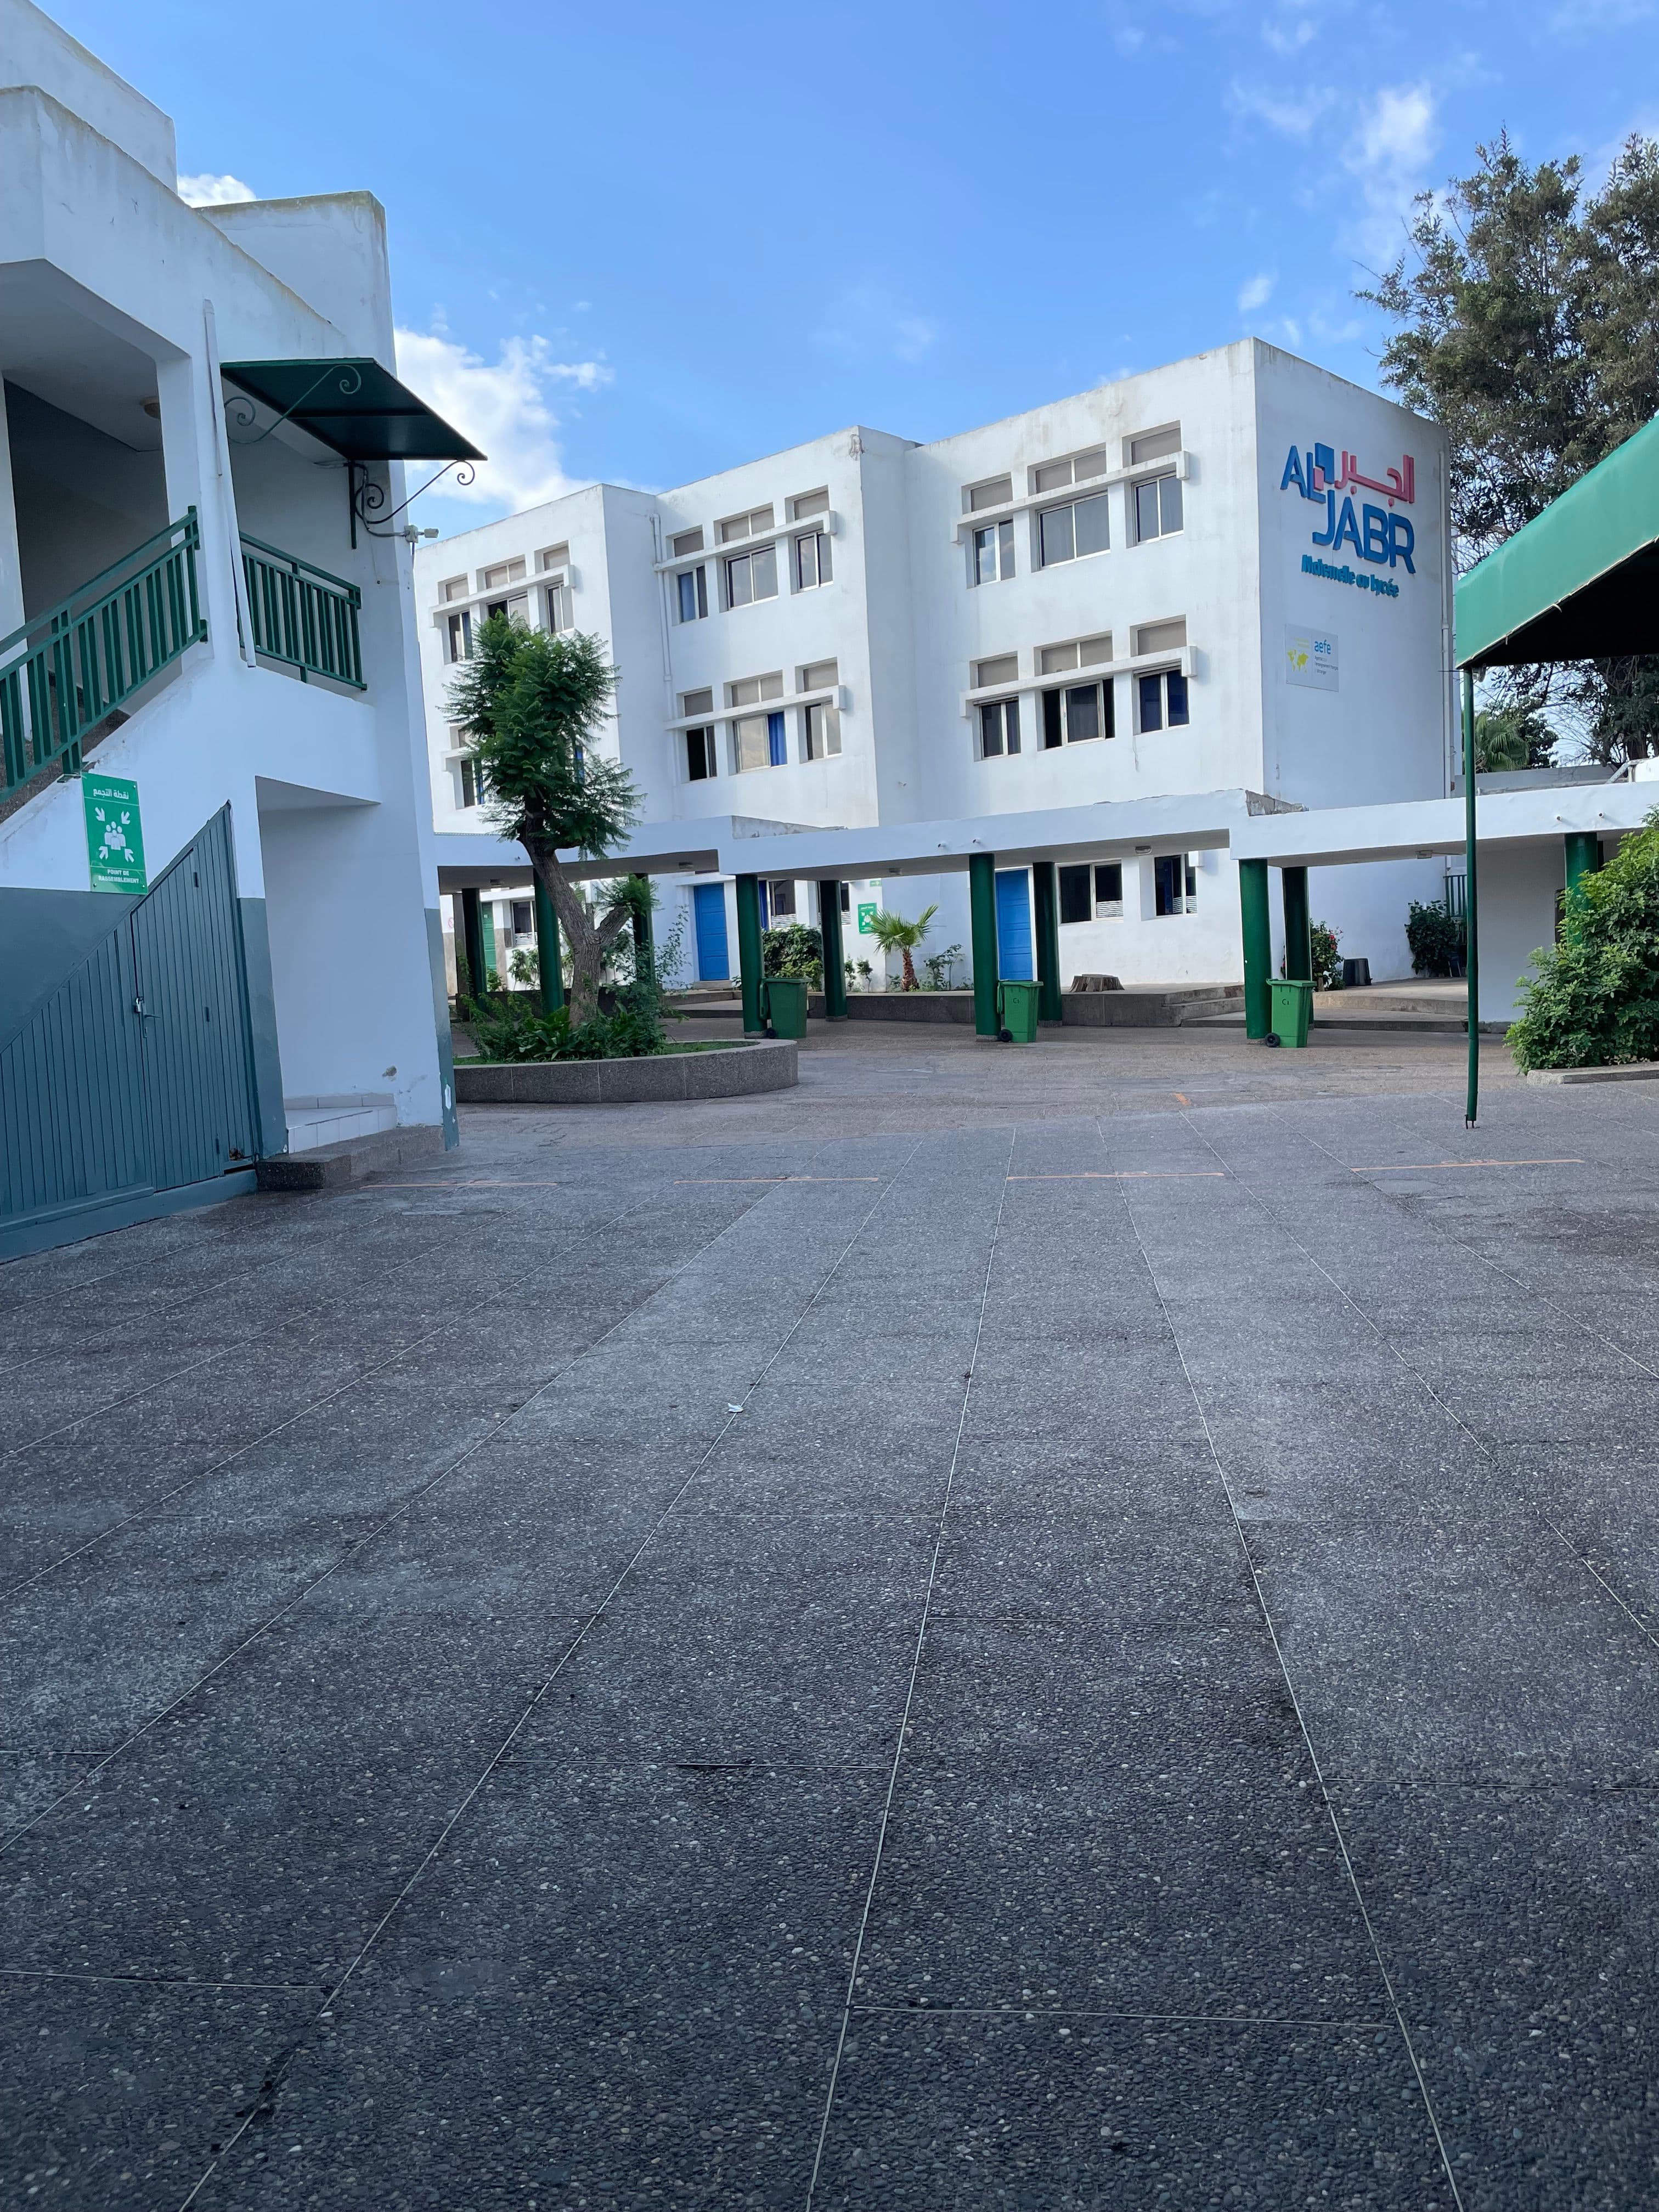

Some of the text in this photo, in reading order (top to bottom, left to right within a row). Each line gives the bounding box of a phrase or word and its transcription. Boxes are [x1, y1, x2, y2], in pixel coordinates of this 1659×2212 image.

[1280, 445, 1326, 504] AL
[1334, 451, 1414, 507] الجبر
[1312, 489, 1416, 574] JABR
[1301, 555, 1400, 597] Maternelle au lycée
[1314, 639, 1331, 654] aefe
[114, 789, 129, 799] نقطة
[98, 875, 139, 884] RASSEMBLEMENT
